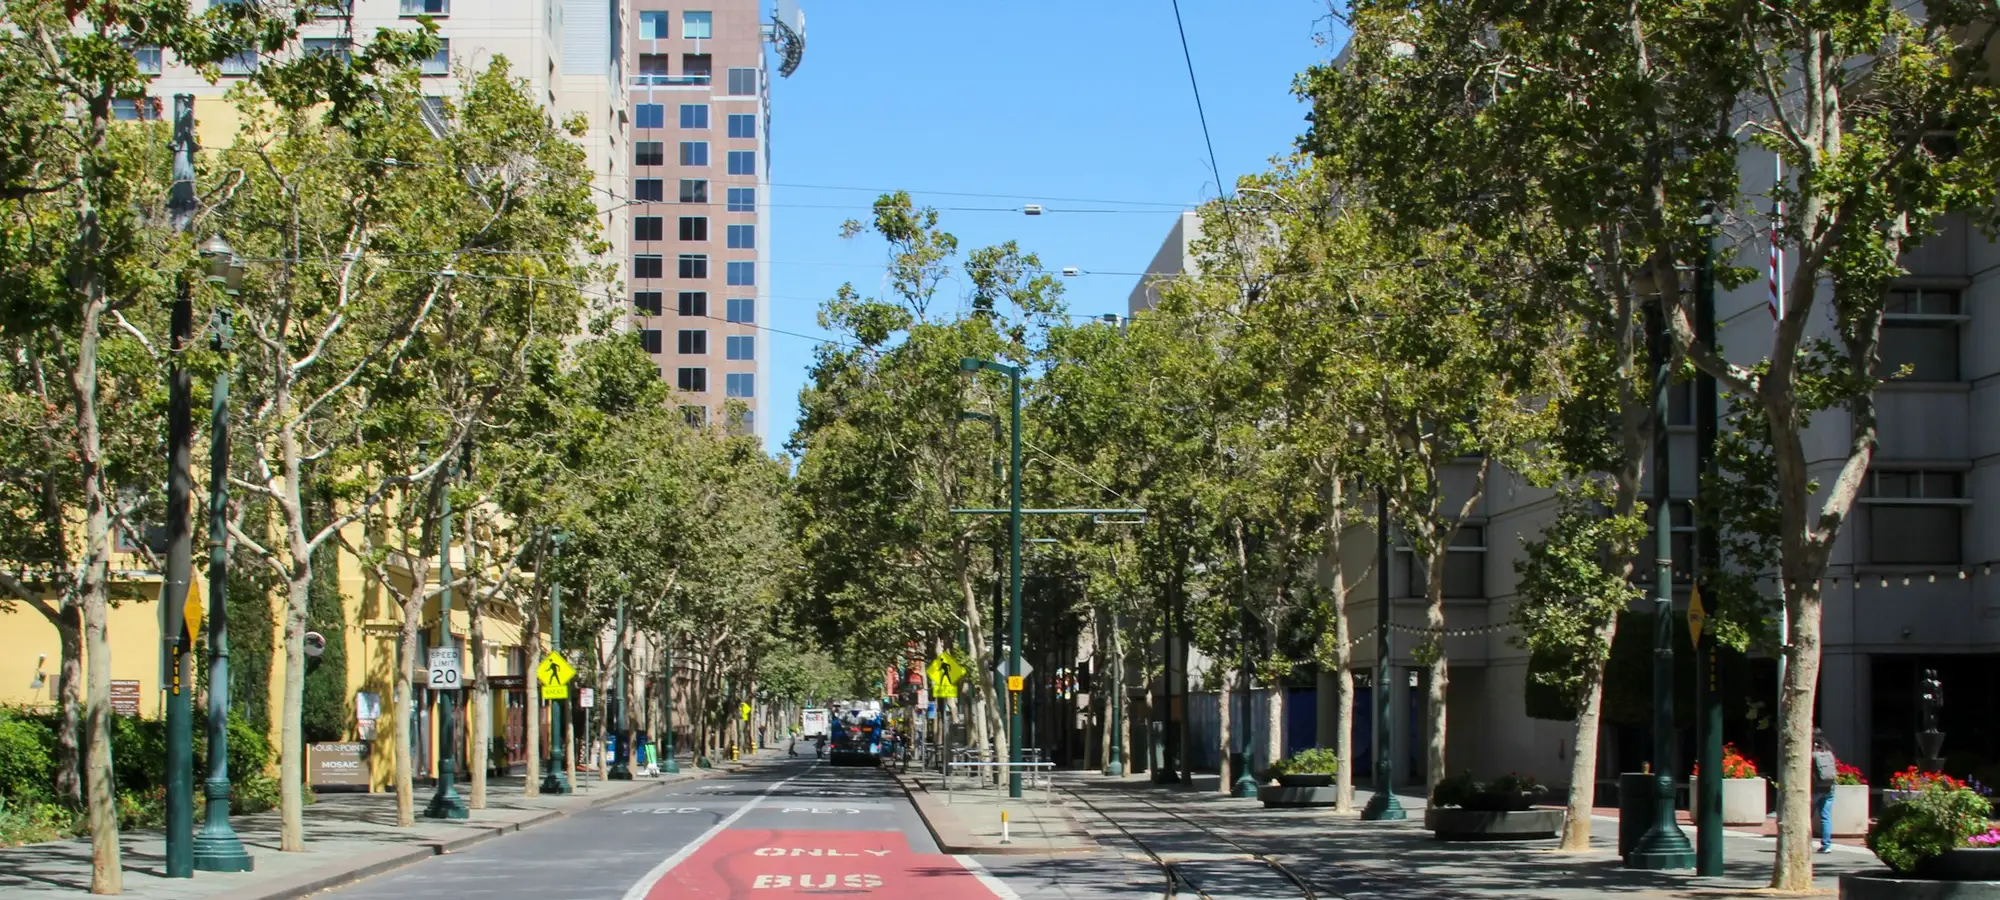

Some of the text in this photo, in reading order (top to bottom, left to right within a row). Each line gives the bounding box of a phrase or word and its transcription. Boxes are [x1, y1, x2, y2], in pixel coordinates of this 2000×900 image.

[433, 670, 457, 684] 20
[753, 848, 892, 857] ONLY
[752, 873, 883, 889] BUS
